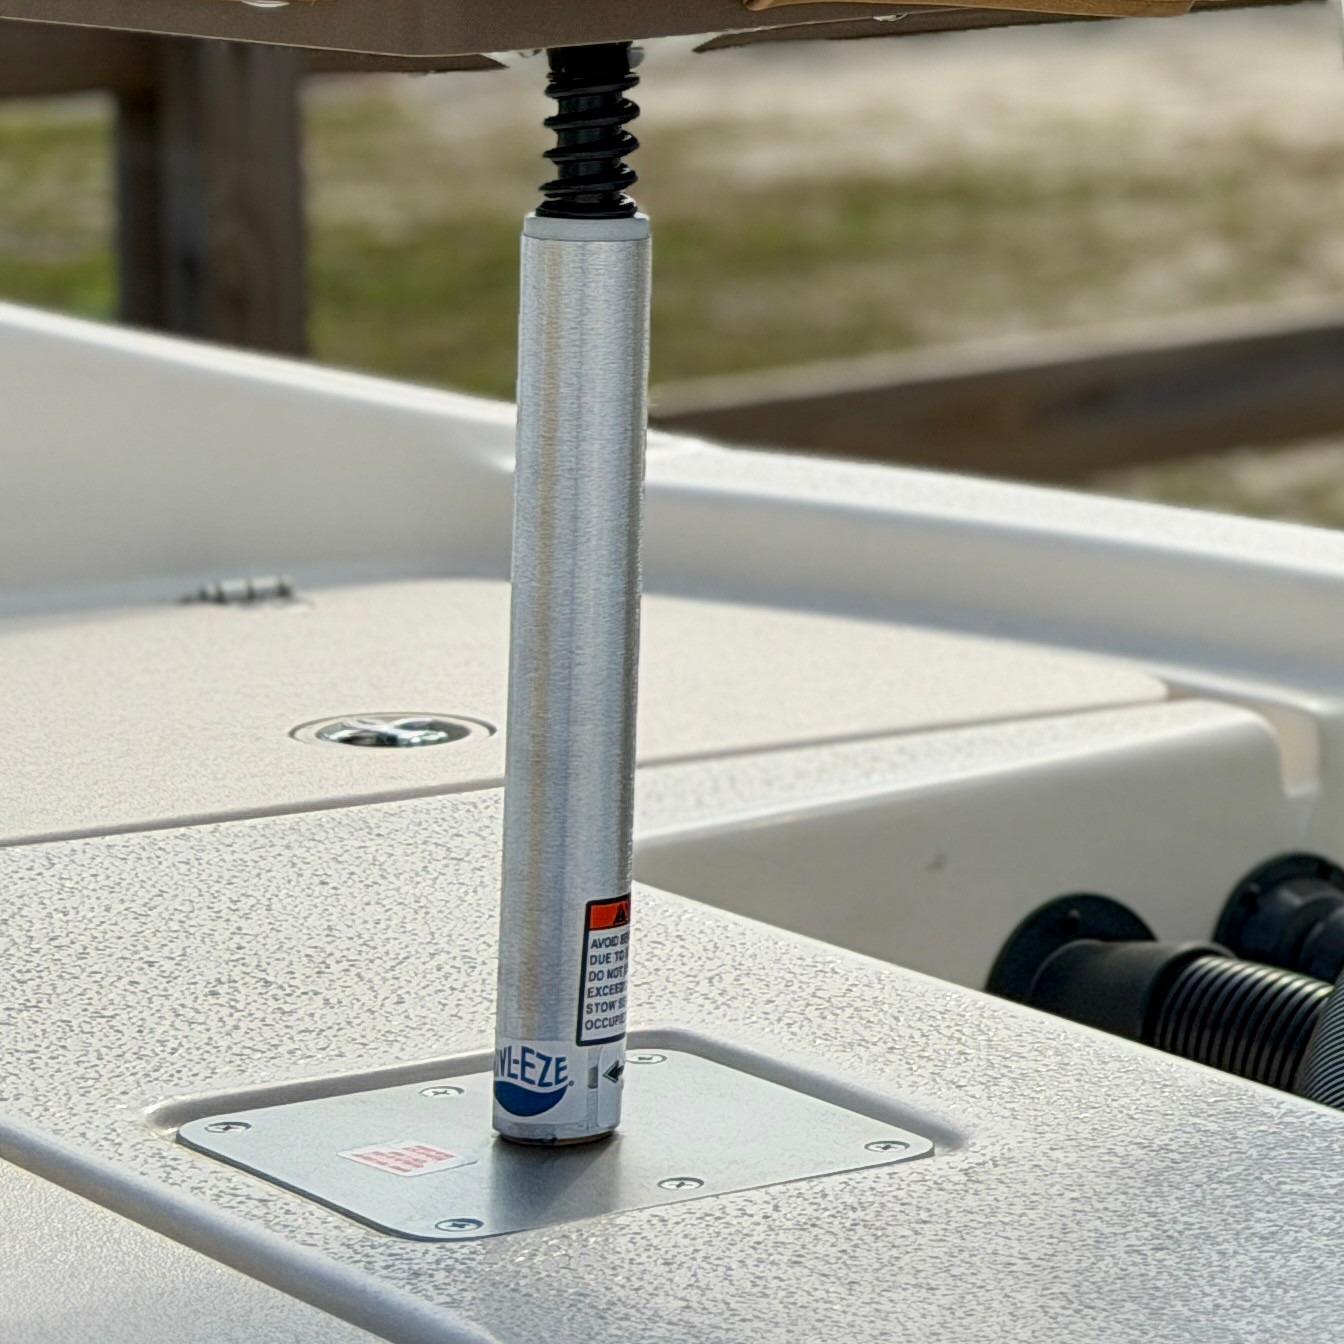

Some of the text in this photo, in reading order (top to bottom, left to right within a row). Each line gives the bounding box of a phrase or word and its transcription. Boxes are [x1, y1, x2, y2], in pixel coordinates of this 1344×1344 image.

[590, 935, 618, 949] AVOID
[589, 952, 612, 966] DUE
[614, 949, 625, 962] TO
[588, 970, 605, 982] DO
[606, 967, 624, 979] NOT
[585, 999, 618, 1015] STOW
